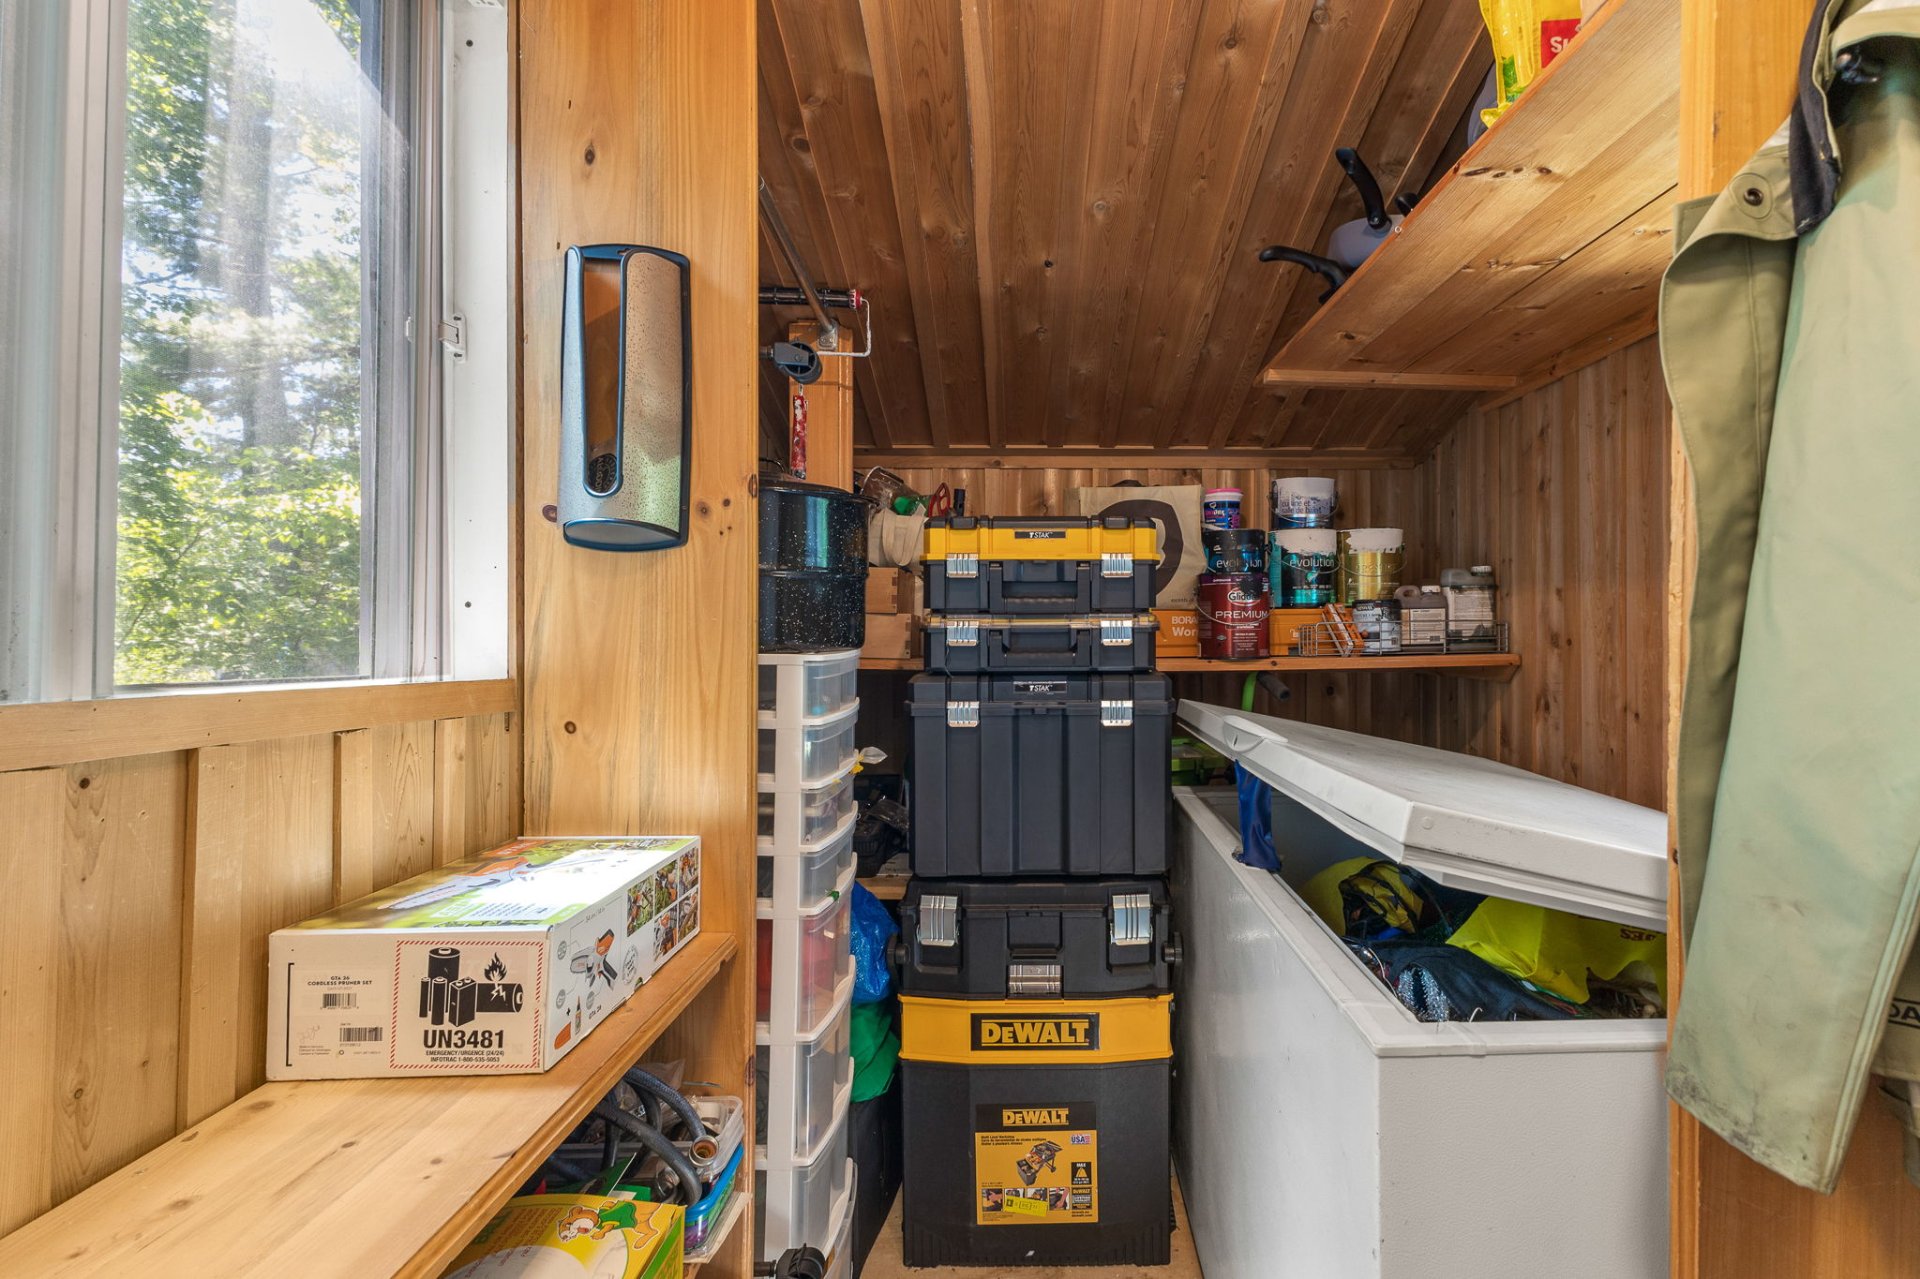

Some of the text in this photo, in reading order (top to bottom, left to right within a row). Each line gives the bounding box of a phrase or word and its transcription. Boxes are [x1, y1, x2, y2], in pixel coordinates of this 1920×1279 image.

[1216, 558, 1262, 569] evolion
[1289, 557, 1335, 568] evolution
[1215, 610, 1268, 620] PREMIUM
[1172, 626, 1199, 637] Wor
[981, 1022, 1089, 1043] DEWALT
[423, 1029, 505, 1049] UN3481
[1004, 1110, 1069, 1124] DEWALT
[1071, 1135, 1085, 1143] USA
